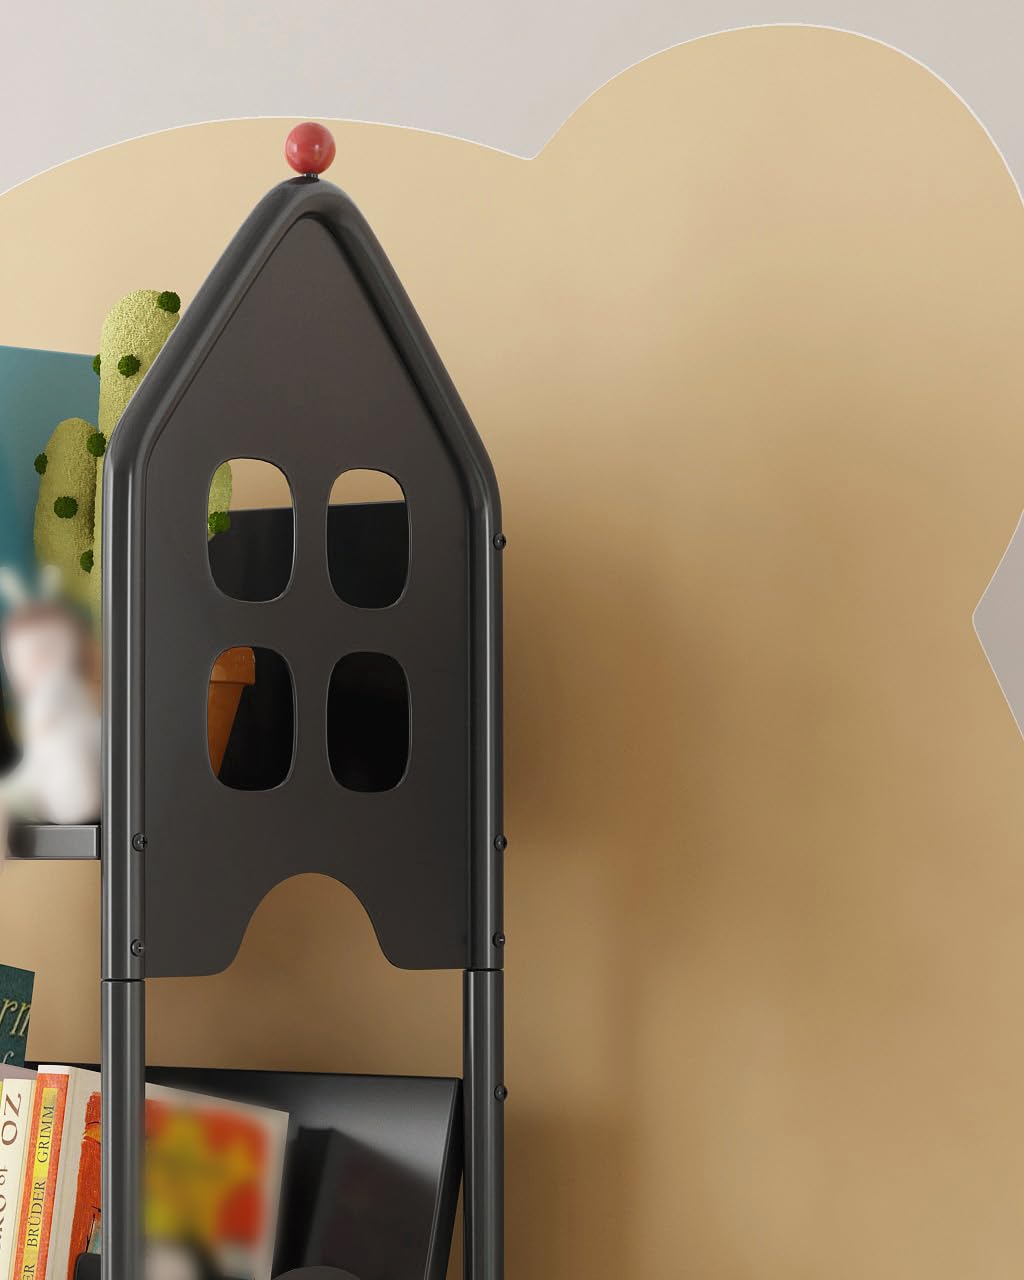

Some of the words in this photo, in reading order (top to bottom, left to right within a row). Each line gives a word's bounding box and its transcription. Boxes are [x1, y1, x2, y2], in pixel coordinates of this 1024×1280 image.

[1, 1093, 22, 1146] OZ
[27, 1180, 46, 1248] BRÜDER
[37, 1105, 55, 1163] GRIMM
